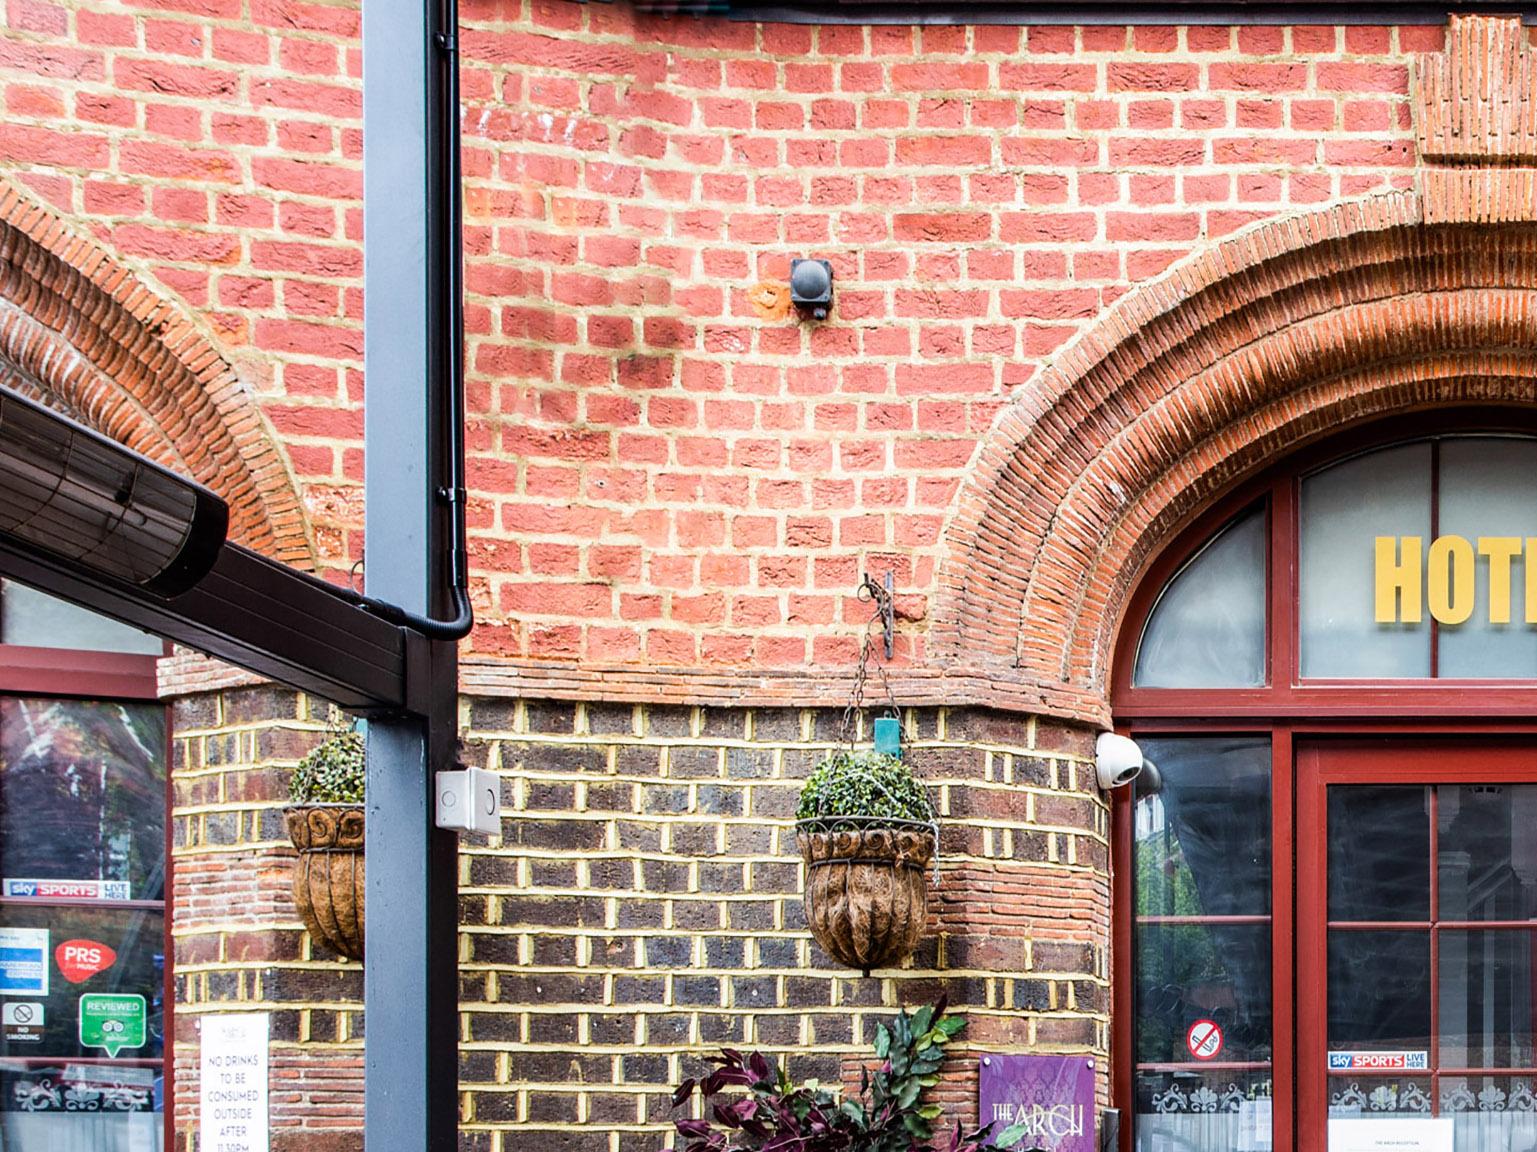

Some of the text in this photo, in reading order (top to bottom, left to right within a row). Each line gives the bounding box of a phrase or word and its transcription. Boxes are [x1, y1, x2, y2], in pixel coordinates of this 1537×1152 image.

[11, 881, 98, 897] sky SPORTS
[104, 883, 127, 892] LIVE
[104, 891, 127, 900] HERE
[64, 946, 102, 963] PRS
[86, 1001, 140, 1012] REVIEWED
[6, 1033, 41, 1041] SMOKING
[208, 1054, 259, 1068] NO DRINKS
[1332, 1054, 1403, 1068] sky SPORTS
[1406, 1053, 1425, 1061] LIVE
[220, 1072, 246, 1085] TO BE
[208, 1090, 259, 1103] CONSUMED
[214, 1108, 253, 1120] OUTSIDE
[992, 1103, 1084, 1137] THE ARCH
[220, 1126, 247, 1137] AFTER
